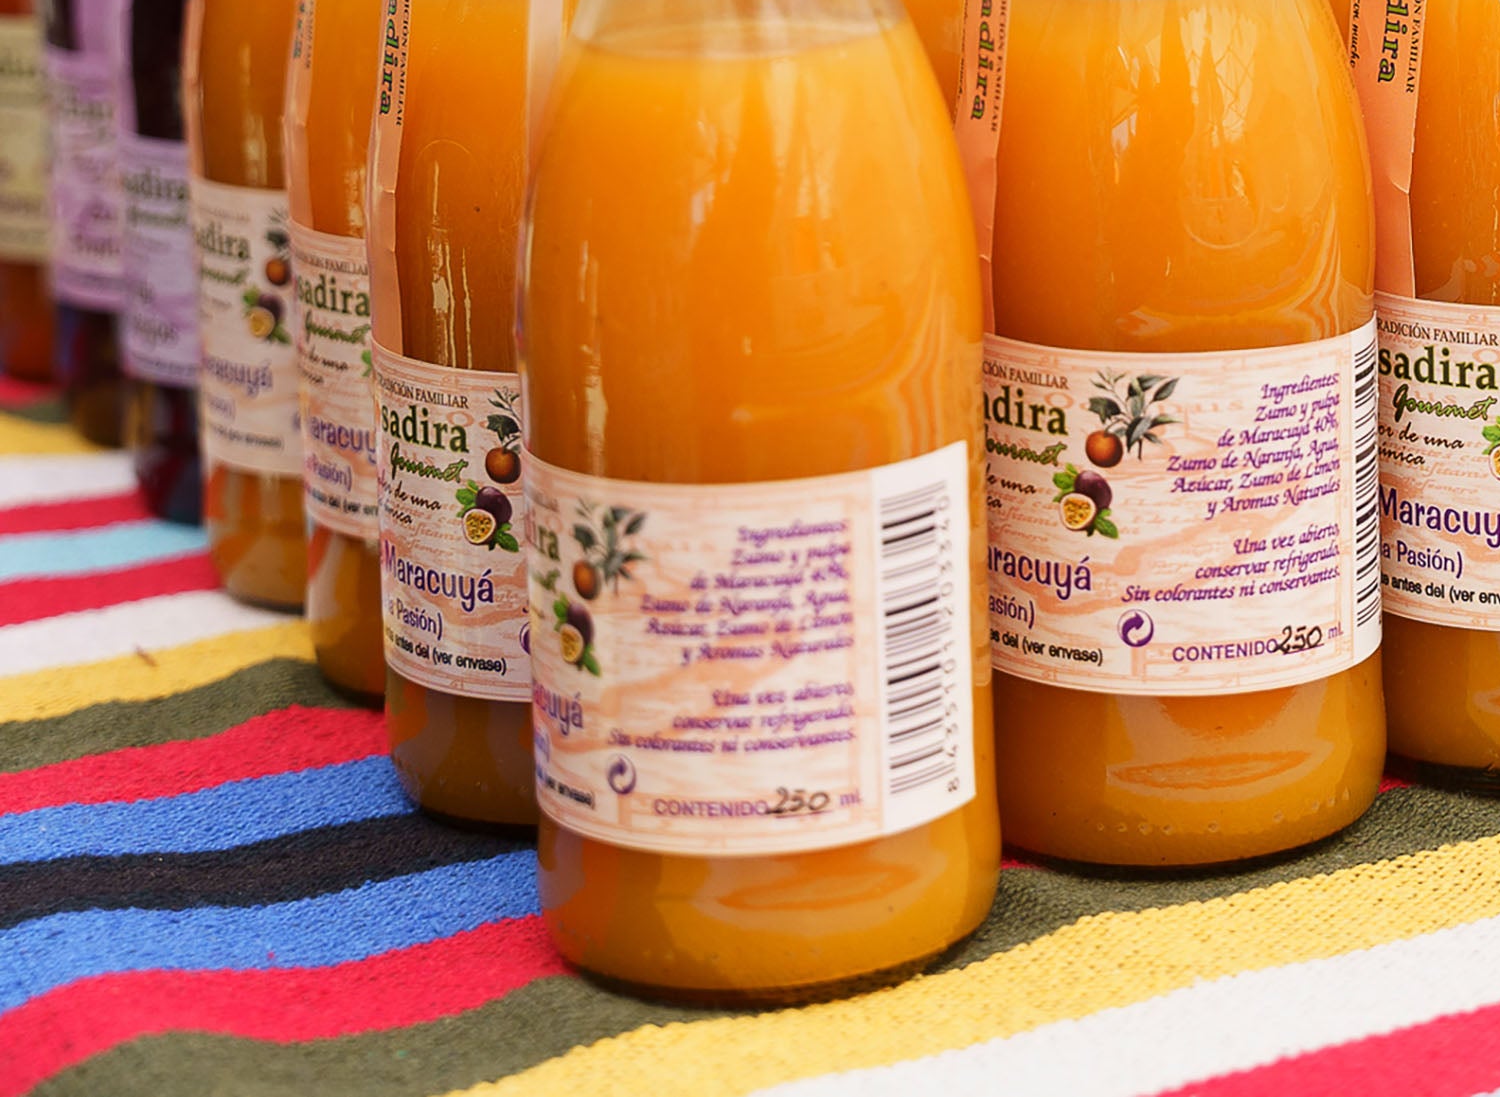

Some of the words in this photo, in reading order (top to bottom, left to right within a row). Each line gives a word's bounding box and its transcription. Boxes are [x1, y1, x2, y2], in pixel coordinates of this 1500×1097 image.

[1405, 16, 1422, 94] FAMILIAR
[1433, 329, 1499, 346] FAMILIAR
[1009, 368, 1069, 390] FAMILIAR
[416, 389, 469, 409] FAMILIAR
[1254, 405, 1297, 422] Zumo
[1298, 402, 1308, 422] y
[1311, 391, 1340, 419] pulpa
[1218, 428, 1234, 447] de
[1239, 421, 1310, 446] Maracuyá
[1399, 421, 1419, 442] de
[1424, 435, 1464, 449] una
[1167, 455, 1217, 471] Zumo
[1221, 450, 1238, 469] de
[1001, 478, 1036, 494] una
[1171, 476, 1234, 493] Azúcar,
[1239, 472, 1284, 489] Zumo
[1287, 463, 1301, 482] de
[411, 495, 441, 510] una
[1205, 500, 1218, 520] y
[1221, 493, 1279, 513] Aromas
[1283, 478, 1340, 505] Naturales
[1233, 538, 1267, 555] Una
[1271, 534, 1295, 550] vez
[1195, 561, 1269, 580] conservar
[1397, 540, 1463, 579] Pasión)
[1121, 585, 1150, 602] Sin
[1155, 583, 1235, 601] colorantes
[1240, 582, 1256, 597] ni
[1392, 574, 1422, 594] antes
[1425, 583, 1445, 599] del
[1450, 585, 1475, 603] (ver
[397, 598, 442, 641] Pasión)
[1002, 631, 1019, 648] del
[1022, 636, 1045, 655] (ver
[1049, 644, 1103, 667] envase)
[1172, 639, 1278, 662] CONTENIDO
[1273, 625, 1323, 653] 250
[415, 642, 429, 659] del
[433, 648, 453, 665] (ver
[456, 655, 507, 675] envase)
[654, 798, 769, 817] CONTENIDO
